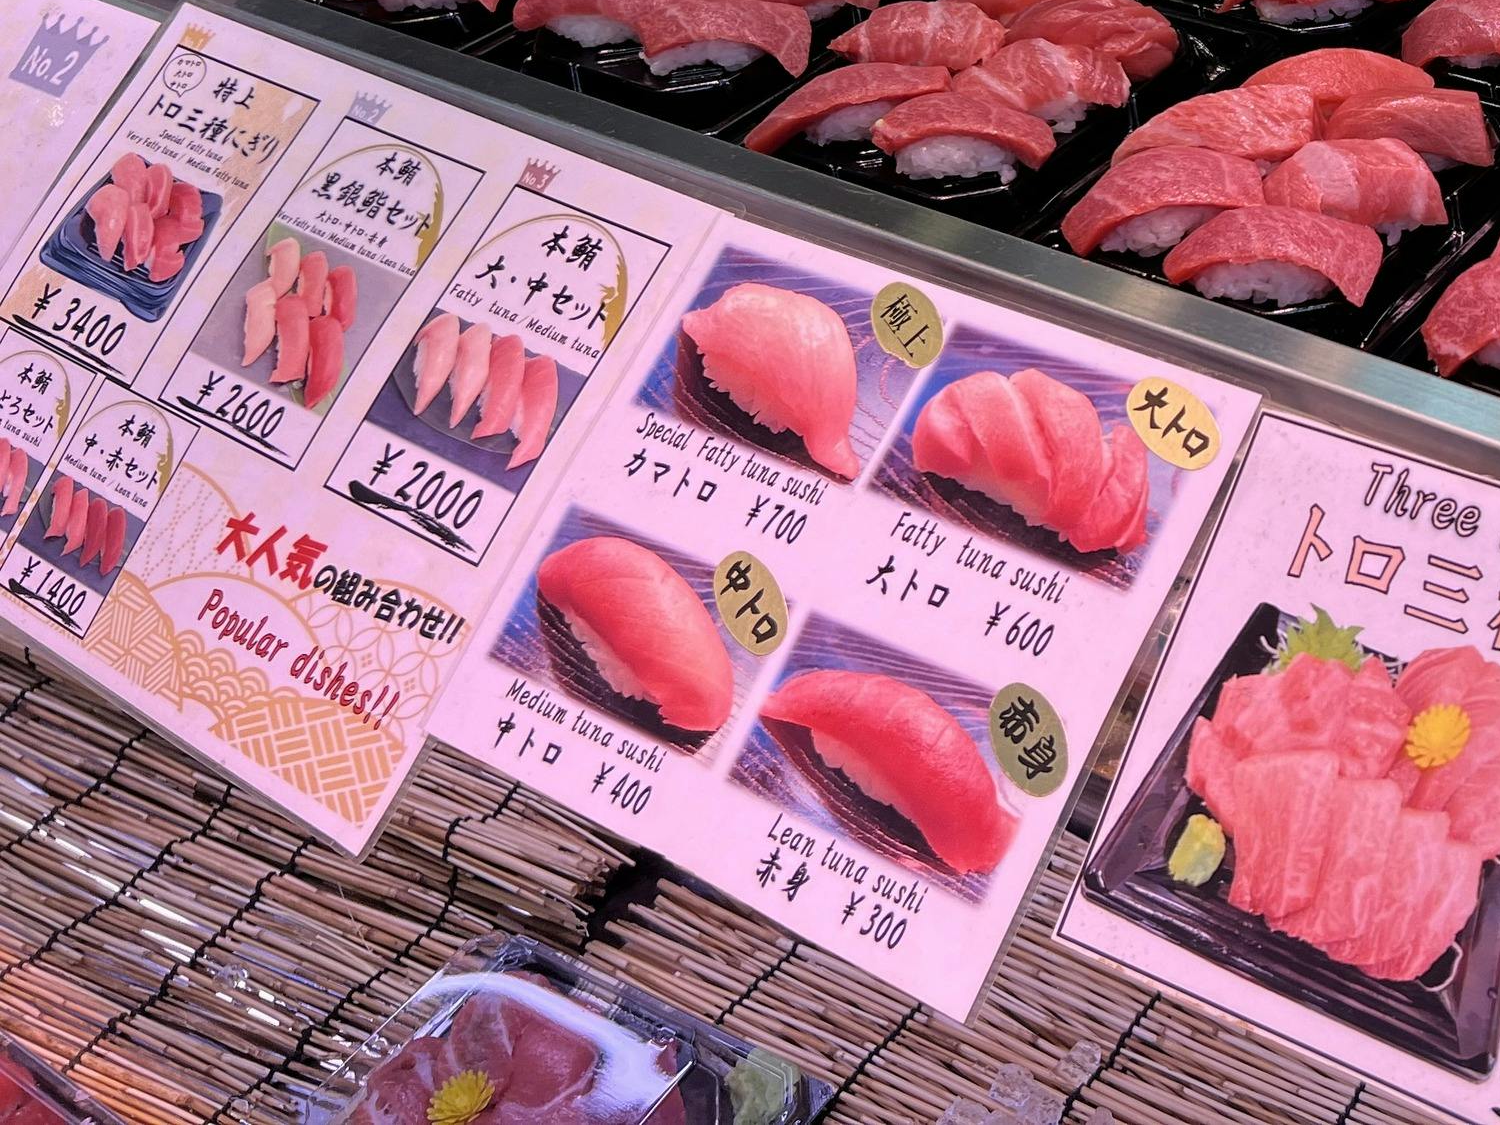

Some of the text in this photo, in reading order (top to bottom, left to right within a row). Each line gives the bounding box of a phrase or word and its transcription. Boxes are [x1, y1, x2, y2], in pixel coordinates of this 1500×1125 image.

[20, 44, 80, 86] No.2
[213, 76, 255, 110] 特上
[126, 130, 143, 144] Very
[143, 137, 161, 152] Fatty
[185, 156, 211, 173] Medium
[148, 93, 280, 165] トロ三種にぎり
[159, 129, 186, 146] Special
[312, 171, 431, 237] 黒銀鮨セット
[376, 151, 422, 186] 本鮪
[541, 225, 603, 272] 本鮪
[449, 284, 483, 307] Fatty
[489, 300, 517, 323] tuna
[571, 334, 601, 360] tuna
[475, 255, 607, 330] 大・中セット
[877, 293, 930, 358] 極上
[17, 363, 53, 395] 本鮪
[118, 415, 156, 449] 本鮪
[1133, 386, 1210, 458] 大トロ
[83, 433, 157, 490] 中・赤セット
[635, 412, 829, 506] Special Fatty tuna sushi
[624, 447, 808, 545] カマトロ ¥700
[1363, 462, 1482, 538] Three
[890, 511, 1071, 605] Fatty tuna sushi
[866, 555, 1055, 658] 大トロ ¥600
[198, 588, 401, 730] Popular dishes!!
[505, 678, 669, 774] Medium tuna sushi
[494, 712, 652, 815] 中トロ ¥400
[756, 847, 908, 950] 赤身 ¥300
[767, 812, 929, 915] Lean tuna sushi
